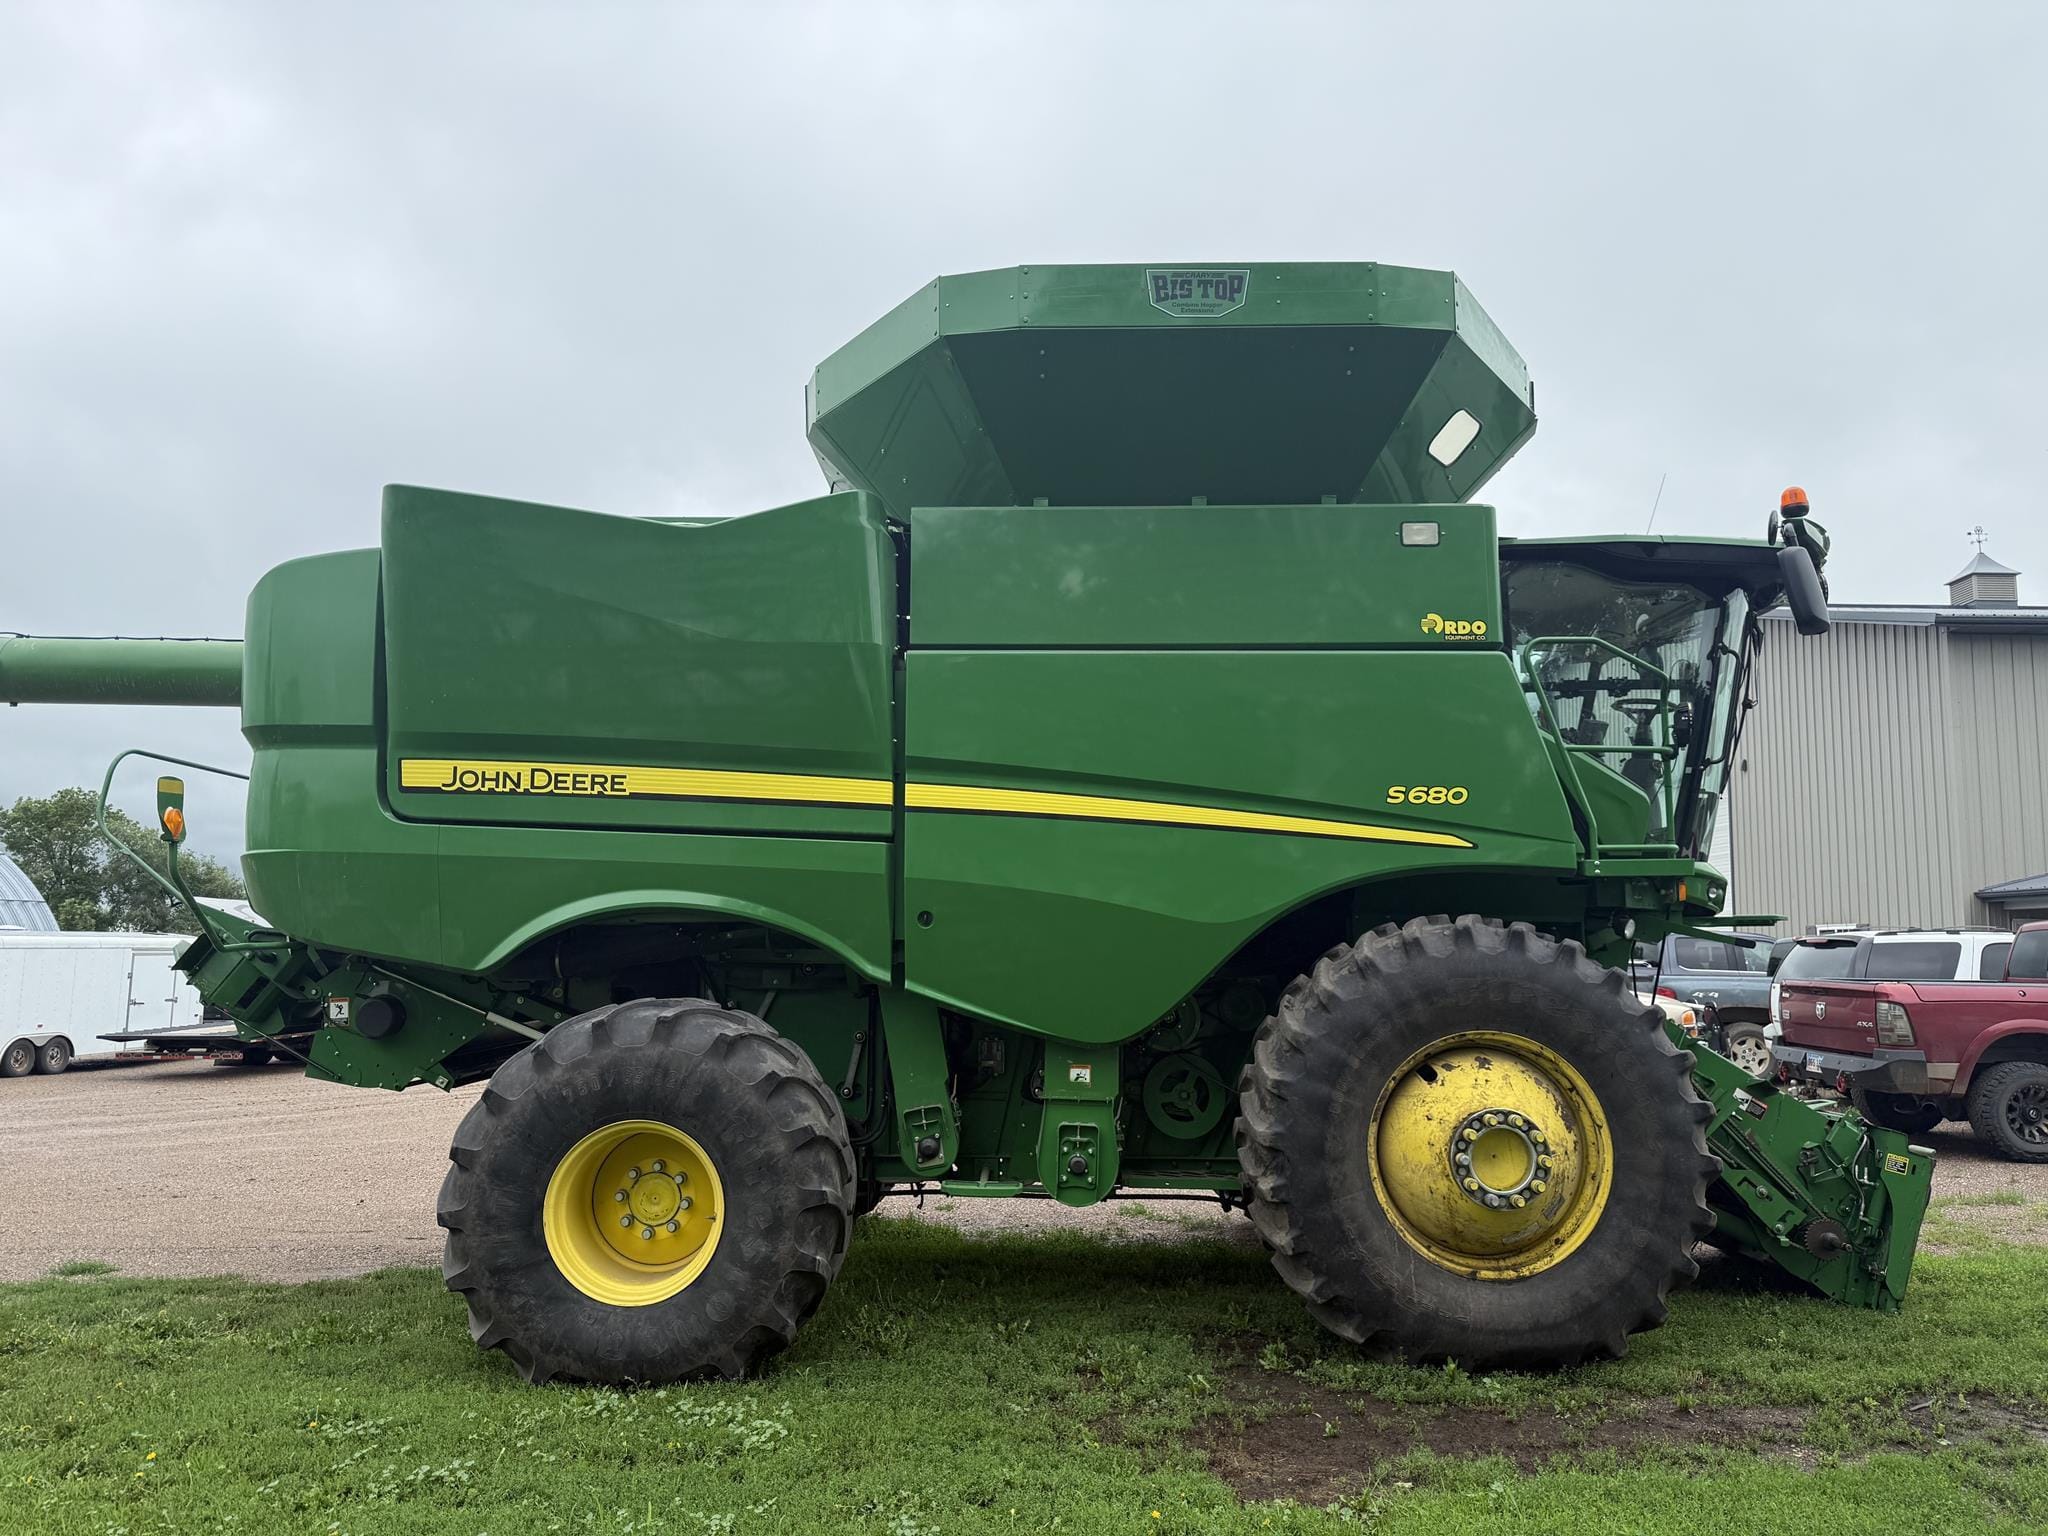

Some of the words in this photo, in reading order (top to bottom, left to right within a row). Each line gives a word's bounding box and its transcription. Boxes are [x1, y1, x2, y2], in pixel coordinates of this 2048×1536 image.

[1152, 275, 1193, 304] BIG
[1197, 275, 1244, 304] TOP
[441, 765, 522, 791] JOHN
[529, 767, 628, 794] DEERE
[1386, 785, 1469, 805] S680
